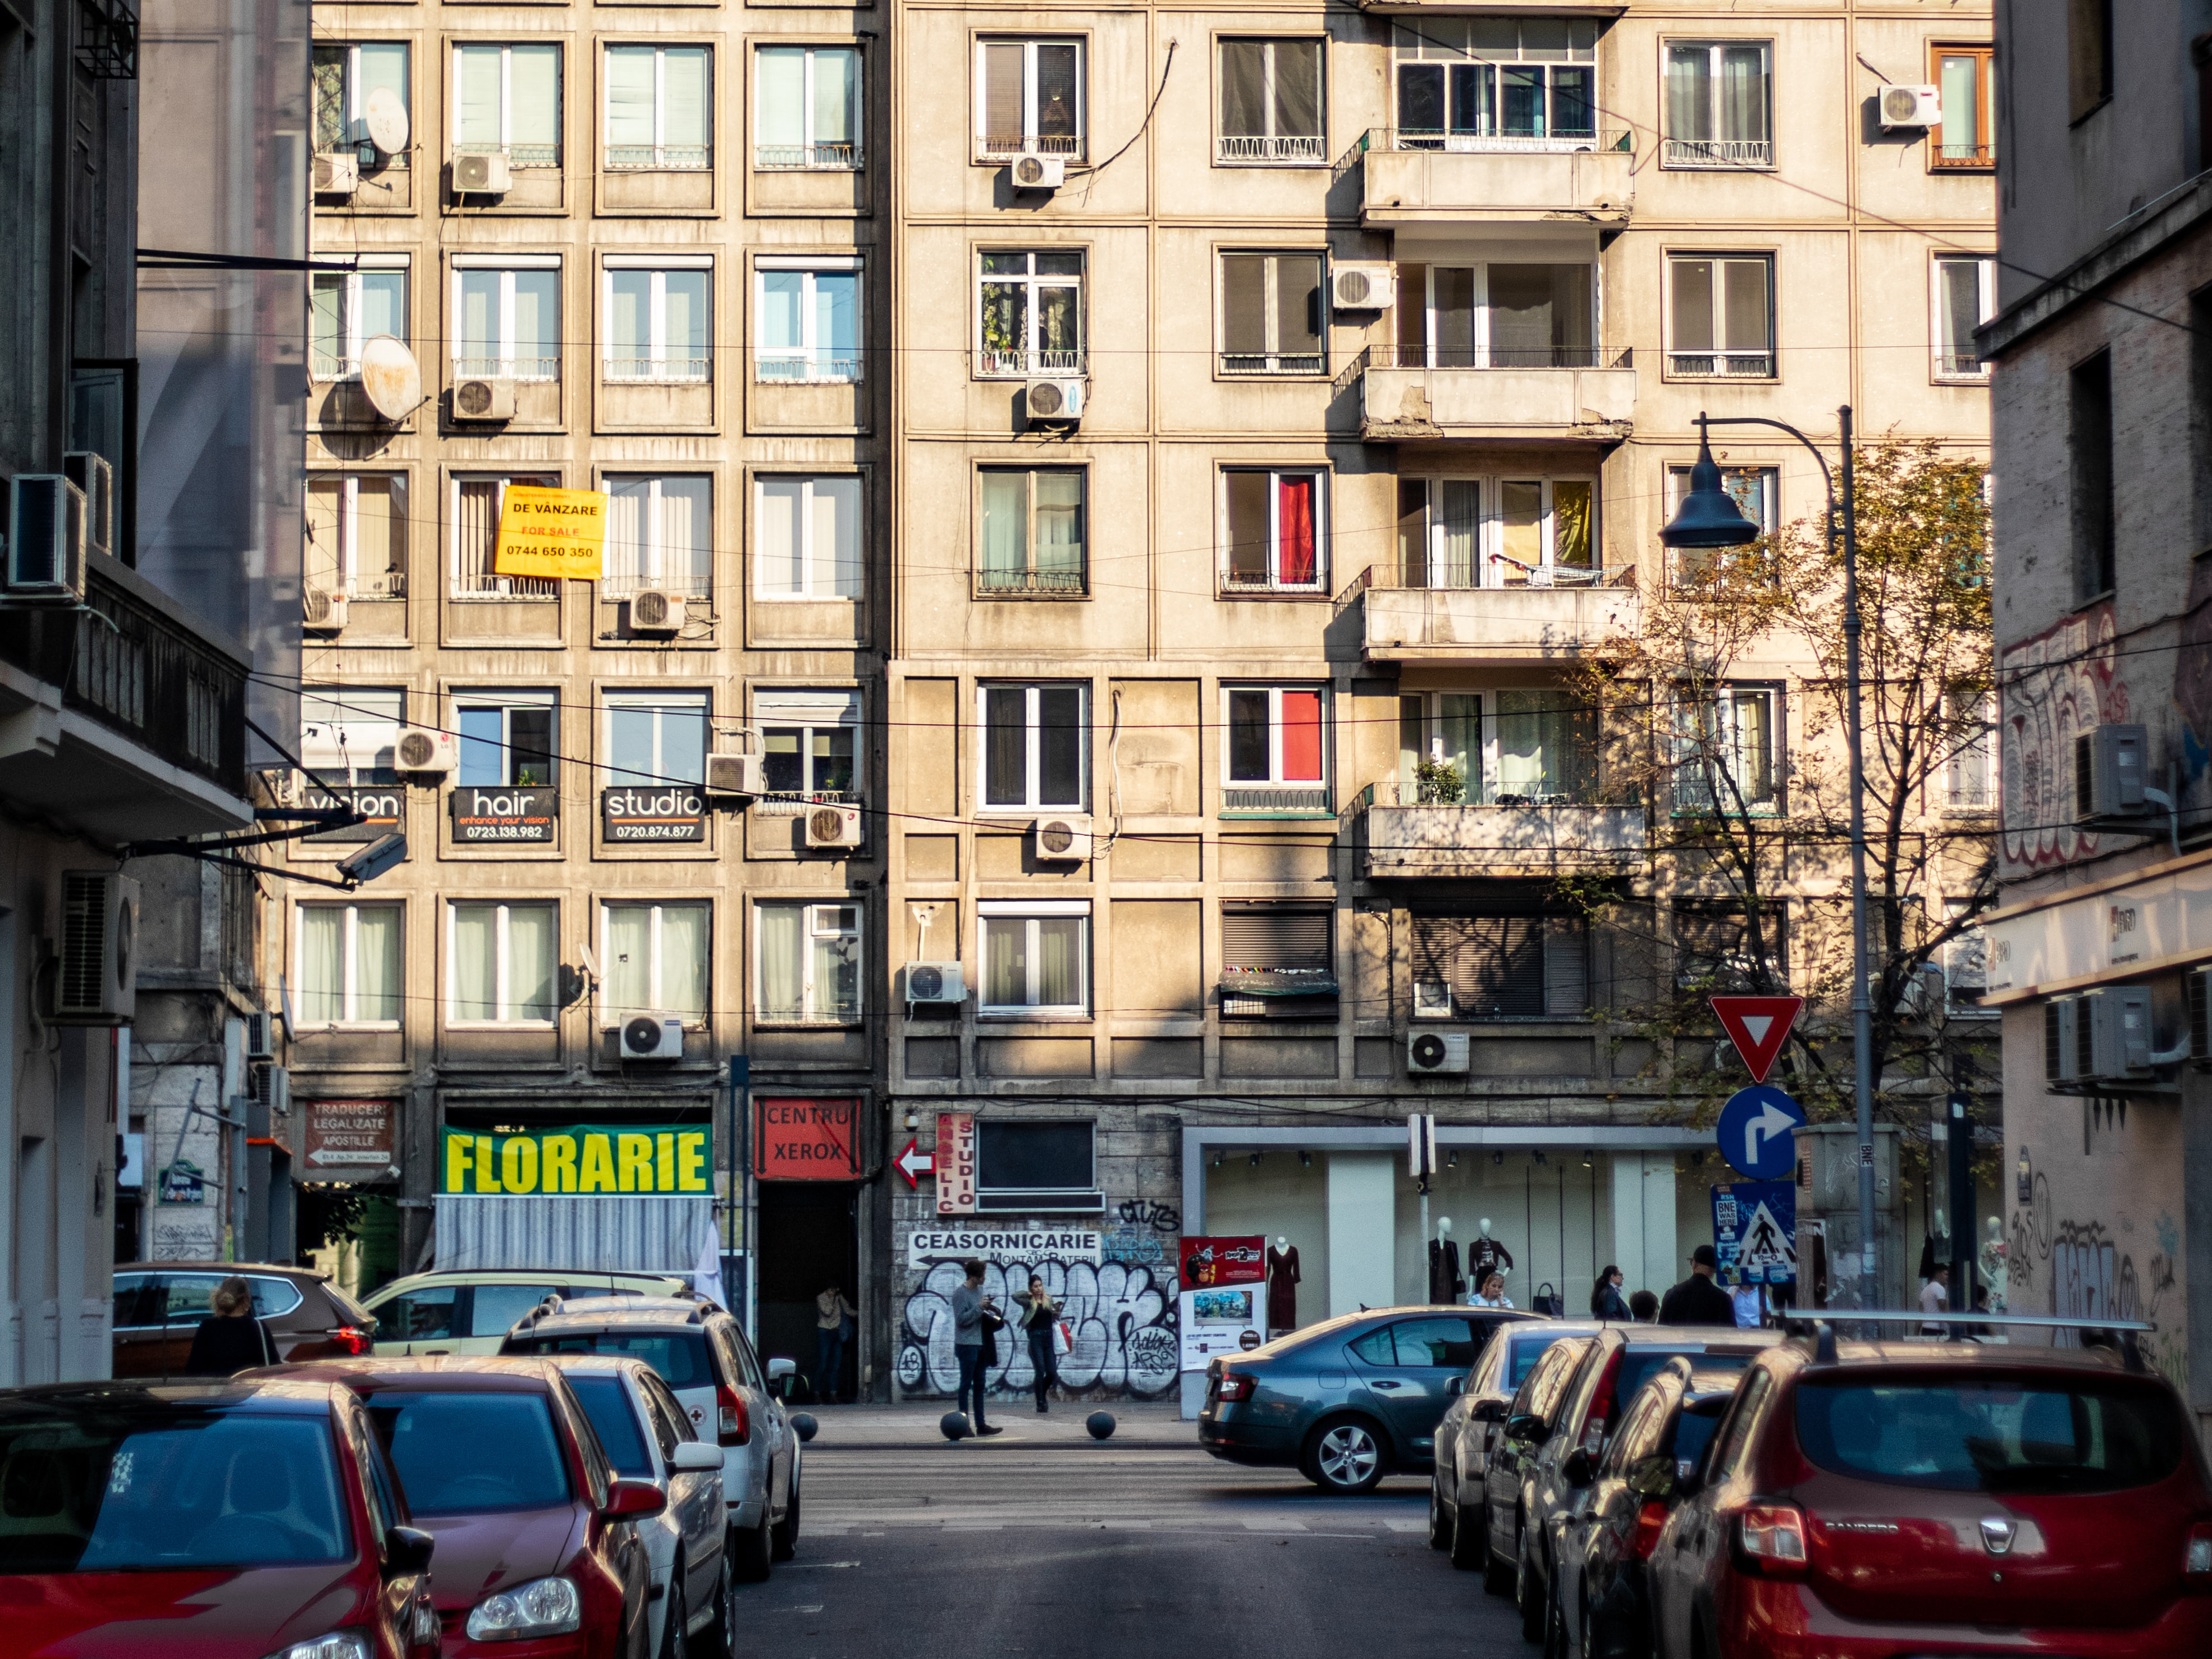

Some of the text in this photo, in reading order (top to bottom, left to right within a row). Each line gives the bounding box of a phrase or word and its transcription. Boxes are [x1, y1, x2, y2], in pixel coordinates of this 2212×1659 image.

[514, 501, 597, 515] DE VÂNZARE
[522, 527, 579, 537] FOR SALE
[507, 546, 593, 557] 0744 650 350
[474, 789, 534, 816] hair
[609, 789, 701, 815] studio
[467, 826, 542, 838] 0723.138.982
[616, 826, 694, 837] 0720.874.877
[767, 1107, 849, 1125] CENTRU
[314, 1118, 386, 1129] LEGALIZATE
[323, 1136, 375, 1146] APOSTILLE
[774, 1142, 842, 1160] XEROX
[1861, 1145, 1873, 1167] BNE
[447, 1132, 706, 1194] FLORARIE
[958, 1122, 974, 1205] STUDIO
[1718, 1202, 1735, 1213] BNE
[914, 1234, 1095, 1249] CEASORNICARIE
